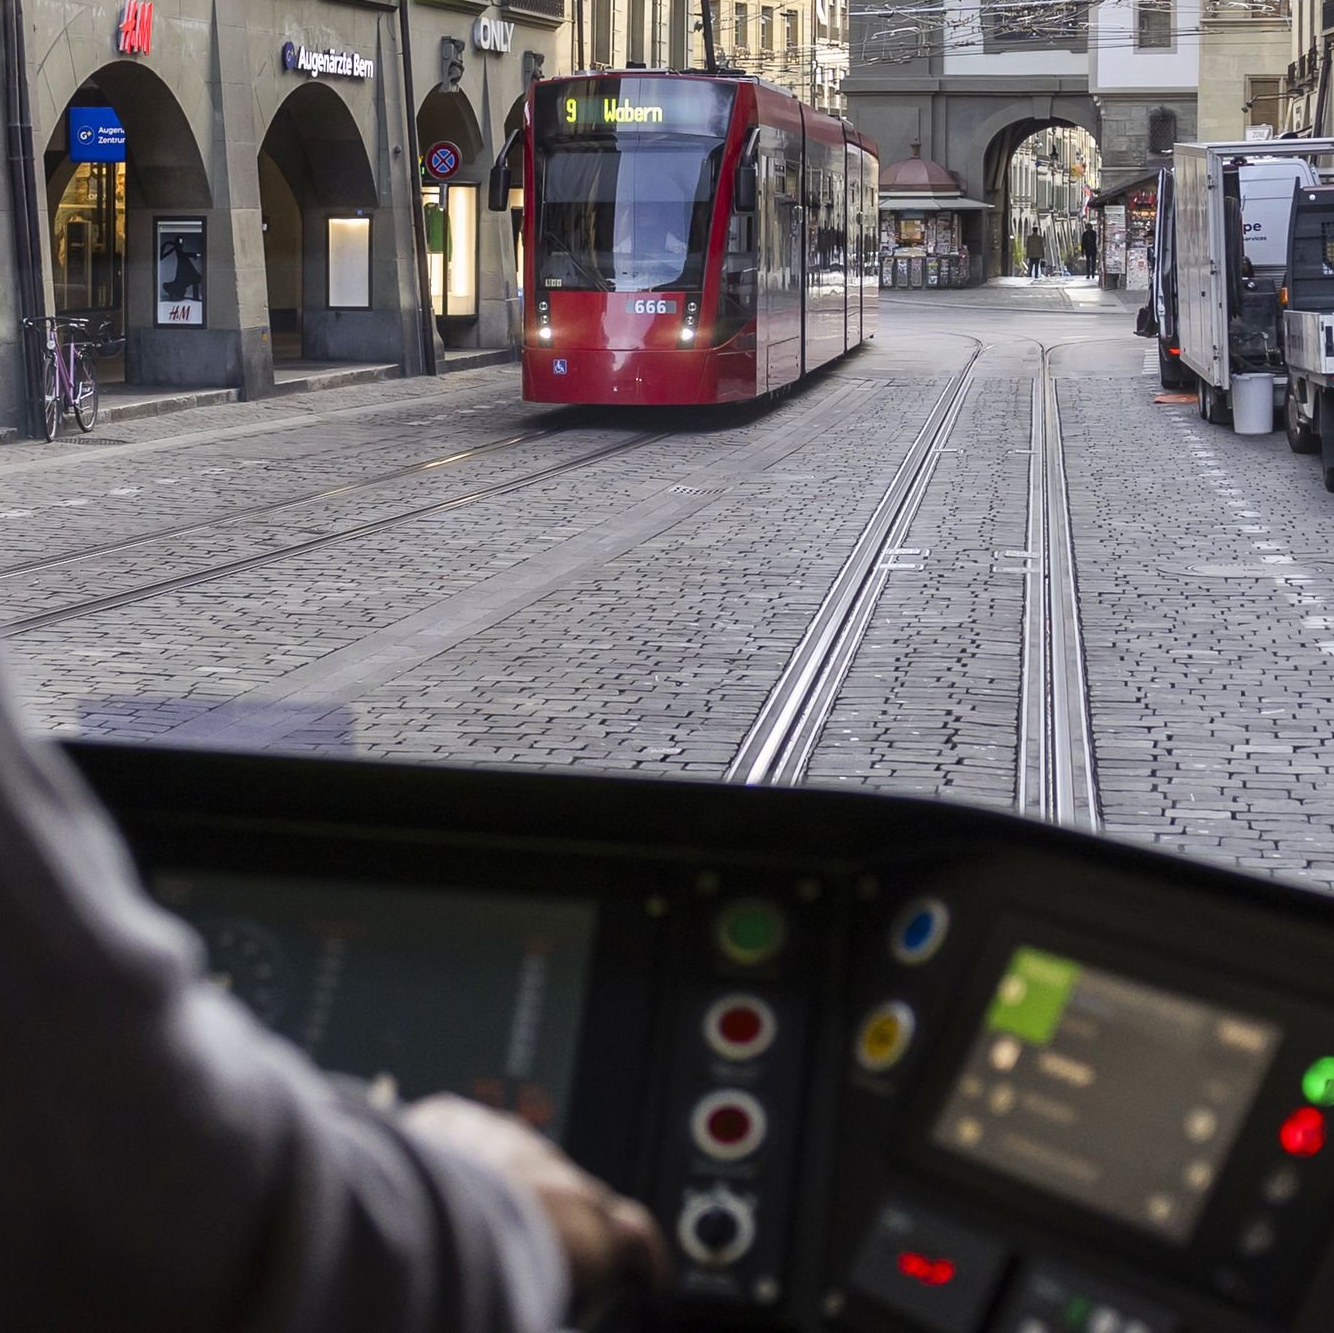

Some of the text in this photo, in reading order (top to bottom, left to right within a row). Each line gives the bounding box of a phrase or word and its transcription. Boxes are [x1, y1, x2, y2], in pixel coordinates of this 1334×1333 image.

[119, 0, 153, 56] H&M
[480, 17, 515, 53] ONLY
[298, 46, 352, 77] Augenärzte
[353, 53, 374, 78] Bern
[567, 98, 663, 122] 9 Wabern
[169, 305, 191, 321] H&M
[635, 300, 666, 314] 666
